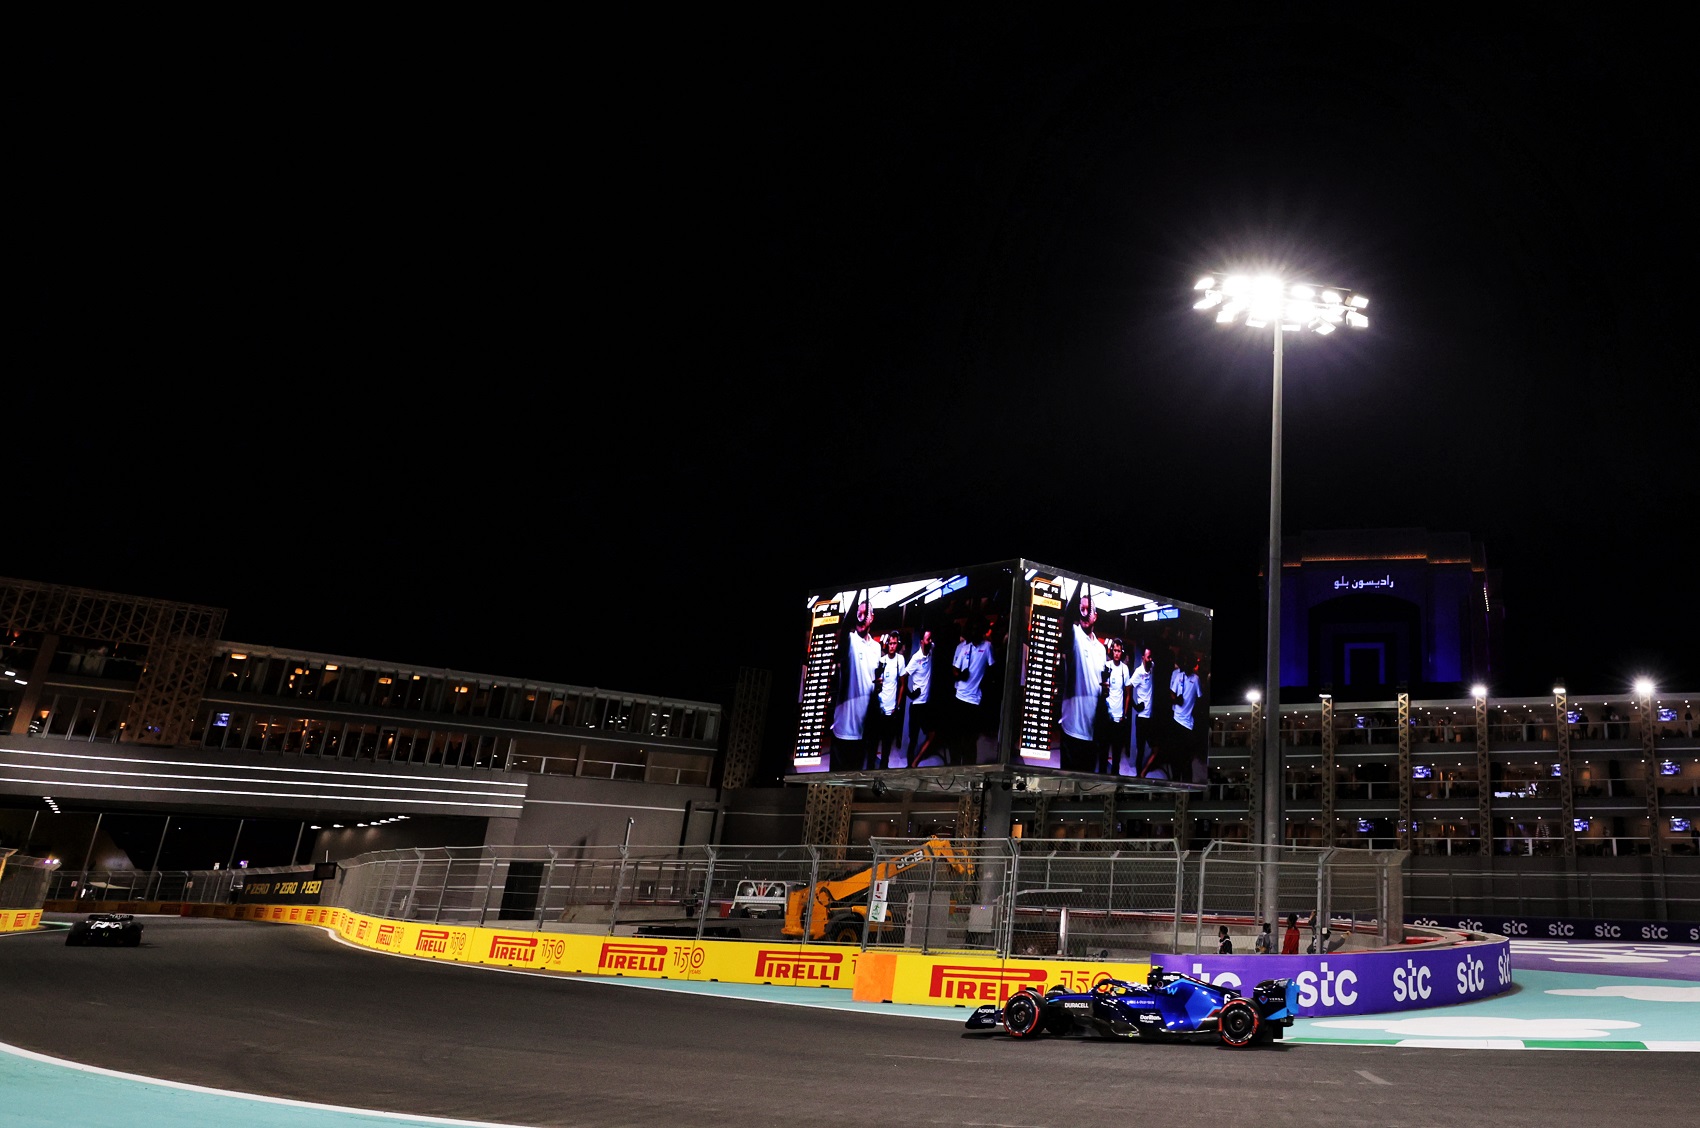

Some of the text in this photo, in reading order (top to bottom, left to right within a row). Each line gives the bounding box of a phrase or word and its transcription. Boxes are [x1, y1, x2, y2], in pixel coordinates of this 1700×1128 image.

[1333, 574, 1394, 589] راديسون بلو
[896, 850, 924, 869] JCB
[279, 881, 299, 894] ZERO
[1502, 920, 1528, 935] stc
[1548, 921, 1575, 937] stc
[1594, 922, 1622, 938] stc
[1641, 924, 1669, 940] stc
[415, 929, 450, 953] PIRELLI
[488, 935, 566, 964] PIRELLI 150
[598, 943, 705, 974] PIRELLI 150
[755, 950, 843, 981] PIRELLI
[929, 965, 1048, 1001] PIRELI
[1296, 962, 1358, 1008] stc
[1393, 959, 1432, 1002] stc
[1457, 954, 1485, 995] stc
